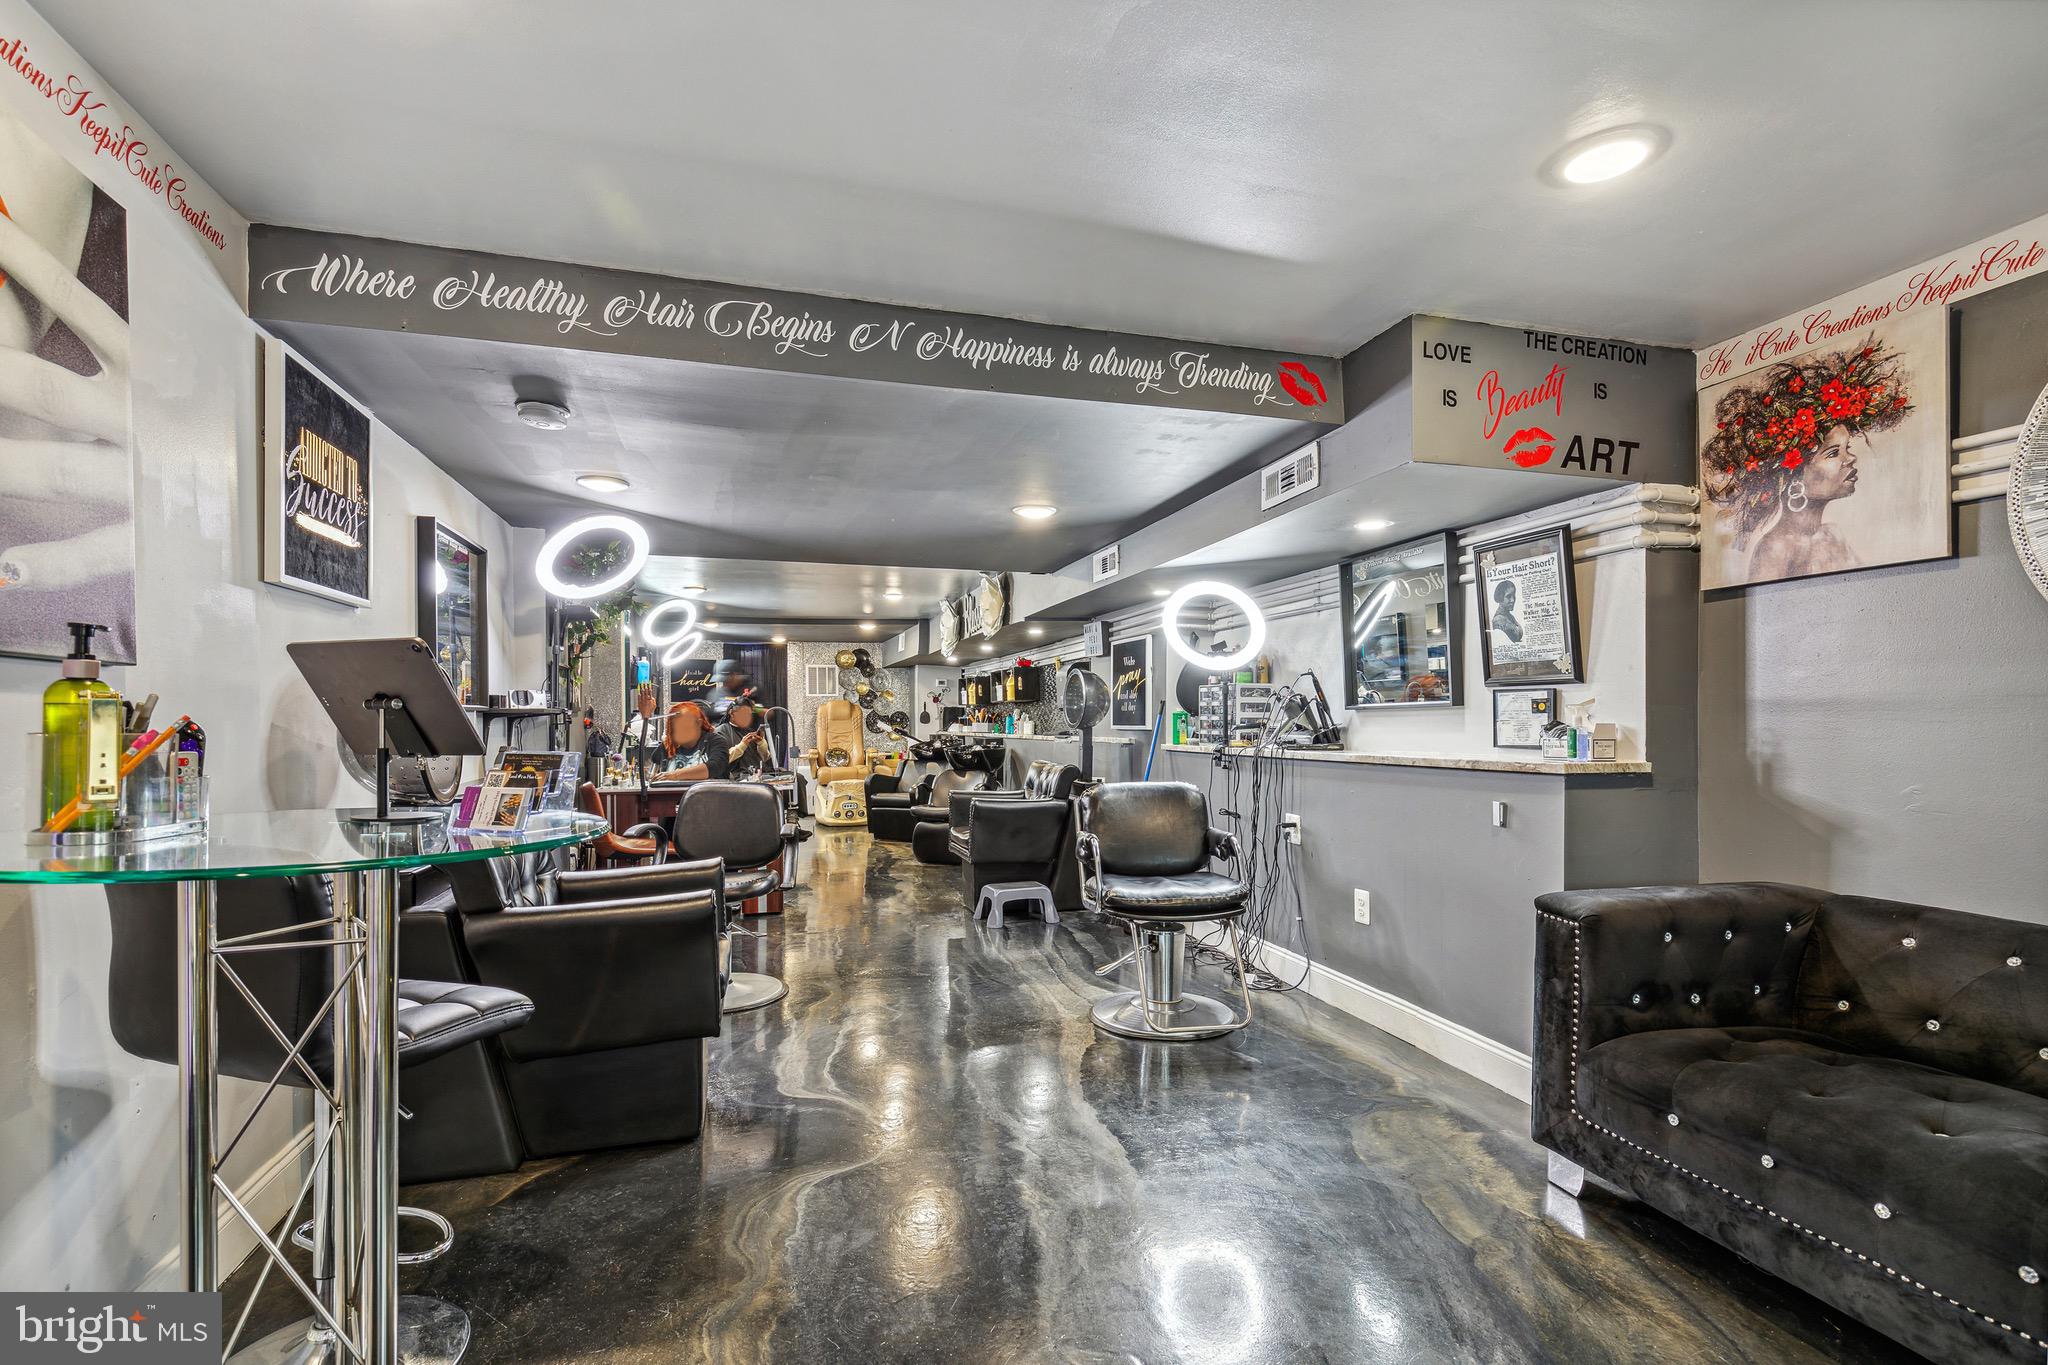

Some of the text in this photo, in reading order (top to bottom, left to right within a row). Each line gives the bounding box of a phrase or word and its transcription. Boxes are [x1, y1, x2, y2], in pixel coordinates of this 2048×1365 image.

[164, 163, 226, 250] Creations
[262, 253, 1294, 406] Where Healthy Hair Begins N Happiness is always Trending
[1802, 301, 1896, 346] Creations
[1423, 341, 1472, 364] LOVE
[1524, 331, 1648, 366] THE CREATION
[1442, 388, 1457, 408] IS
[1477, 363, 1570, 440] Beauty
[1594, 382, 1608, 400] IS
[299, 427, 359, 503] ADDICTED TO
[1560, 434, 1640, 475] ART
[286, 444, 366, 543] Success
[1486, 556, 1555, 578] Is Your Hair Short?
[671, 673, 717, 687] hard
[1113, 668, 1147, 700] pray
[1128, 702, 1136, 714] day
